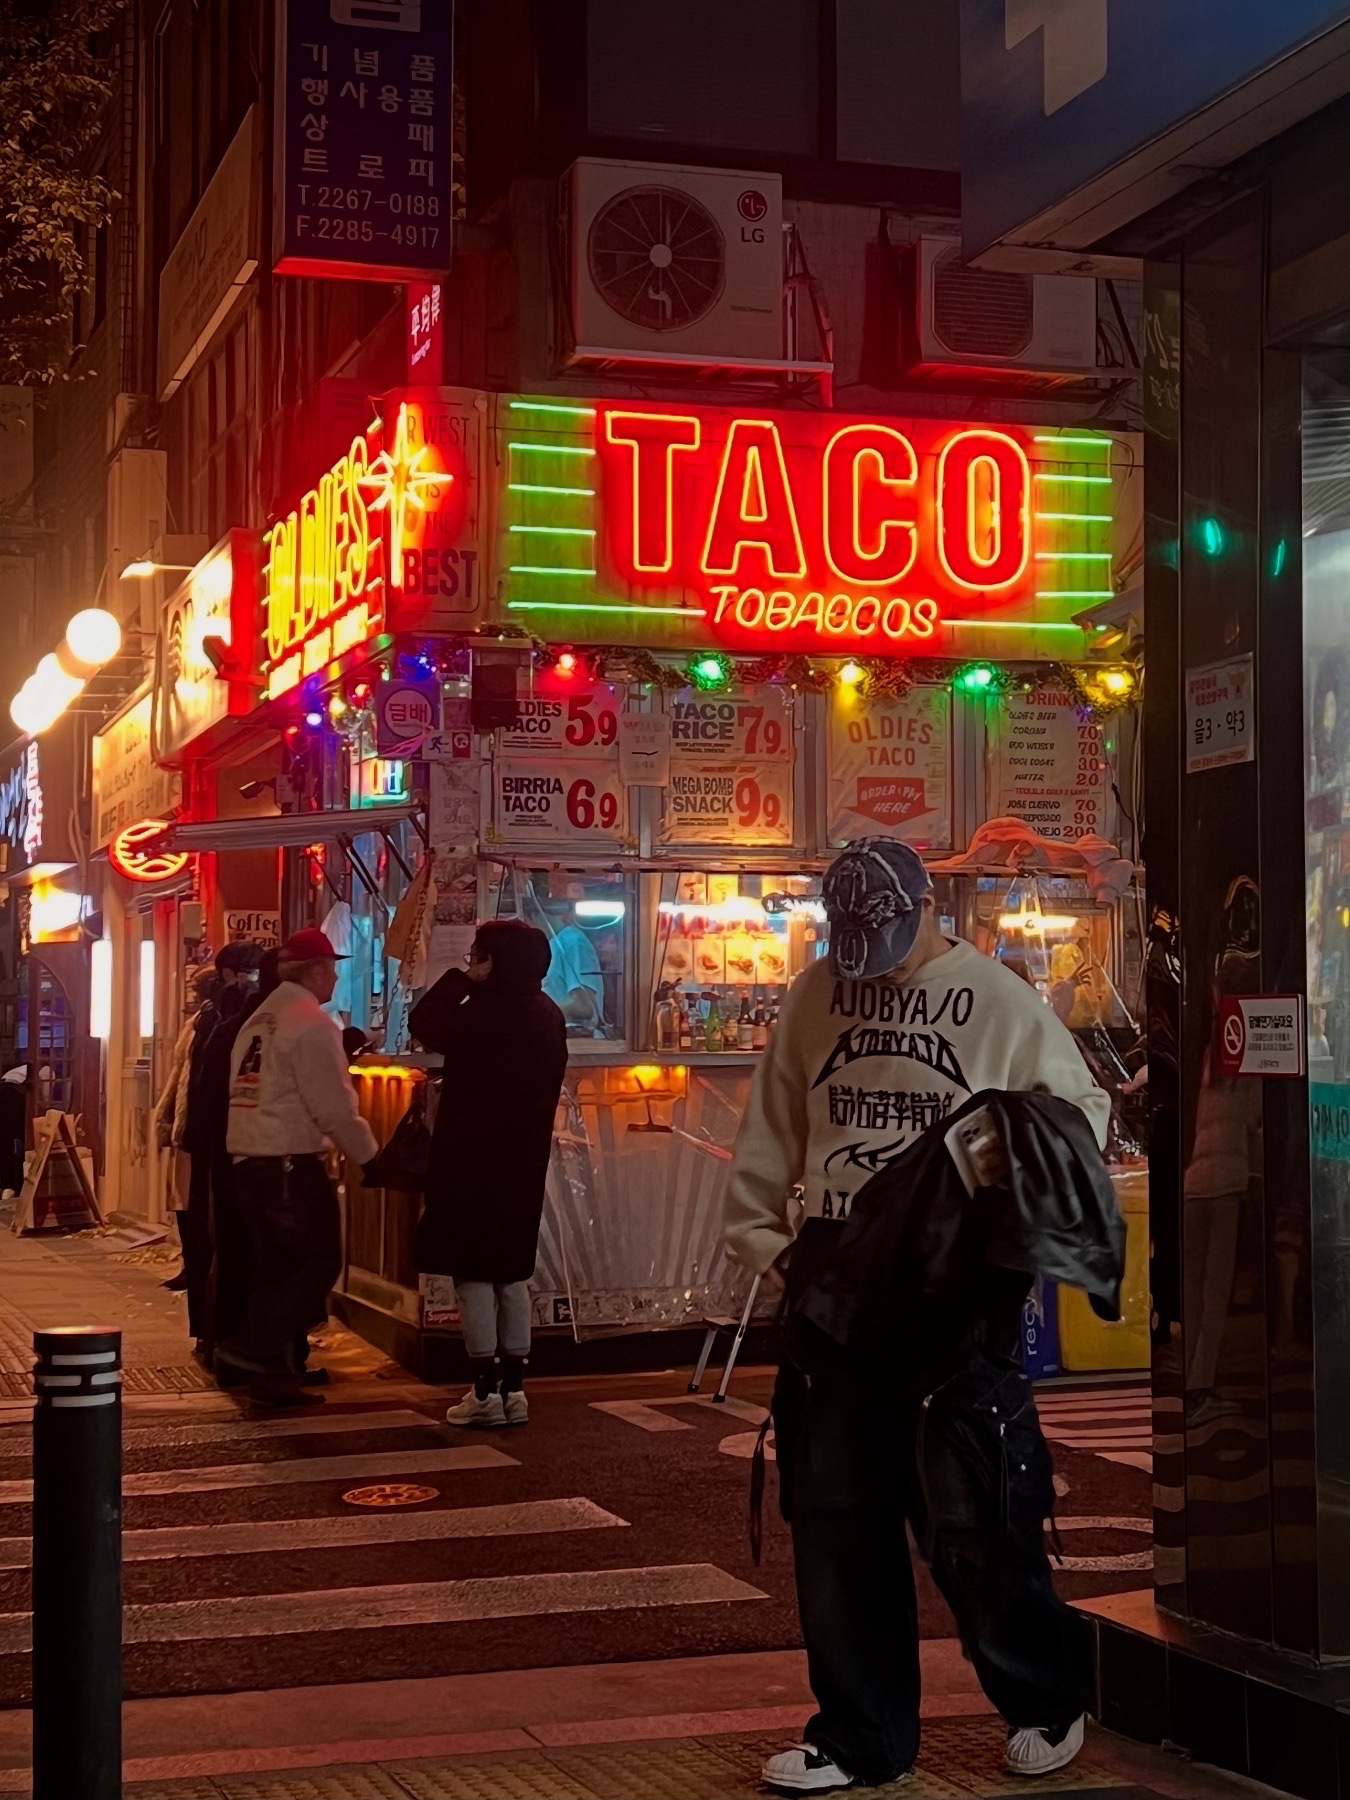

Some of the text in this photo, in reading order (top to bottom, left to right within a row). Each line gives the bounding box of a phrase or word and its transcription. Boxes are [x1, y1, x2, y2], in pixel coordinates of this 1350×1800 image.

[298, 184, 439, 217] T.2267-0188
[296, 215, 439, 249] F.2285-4917
[741, 227, 765, 243] LG
[605, 410, 1031, 591] TACO
[403, 548, 477, 598] BEST
[709, 585, 939, 638] TOBACCOS
[514, 700, 562, 718] LDIES
[672, 702, 735, 721] TACO
[672, 720, 735, 740] RICE
[848, 715, 934, 745] OLDIES
[867, 746, 916, 766] TACO
[502, 776, 564, 795] BIRRIA
[672, 777, 734, 795] MEGA BOMB
[502, 795, 551, 813] TACO
[672, 795, 734, 814] SNACK
